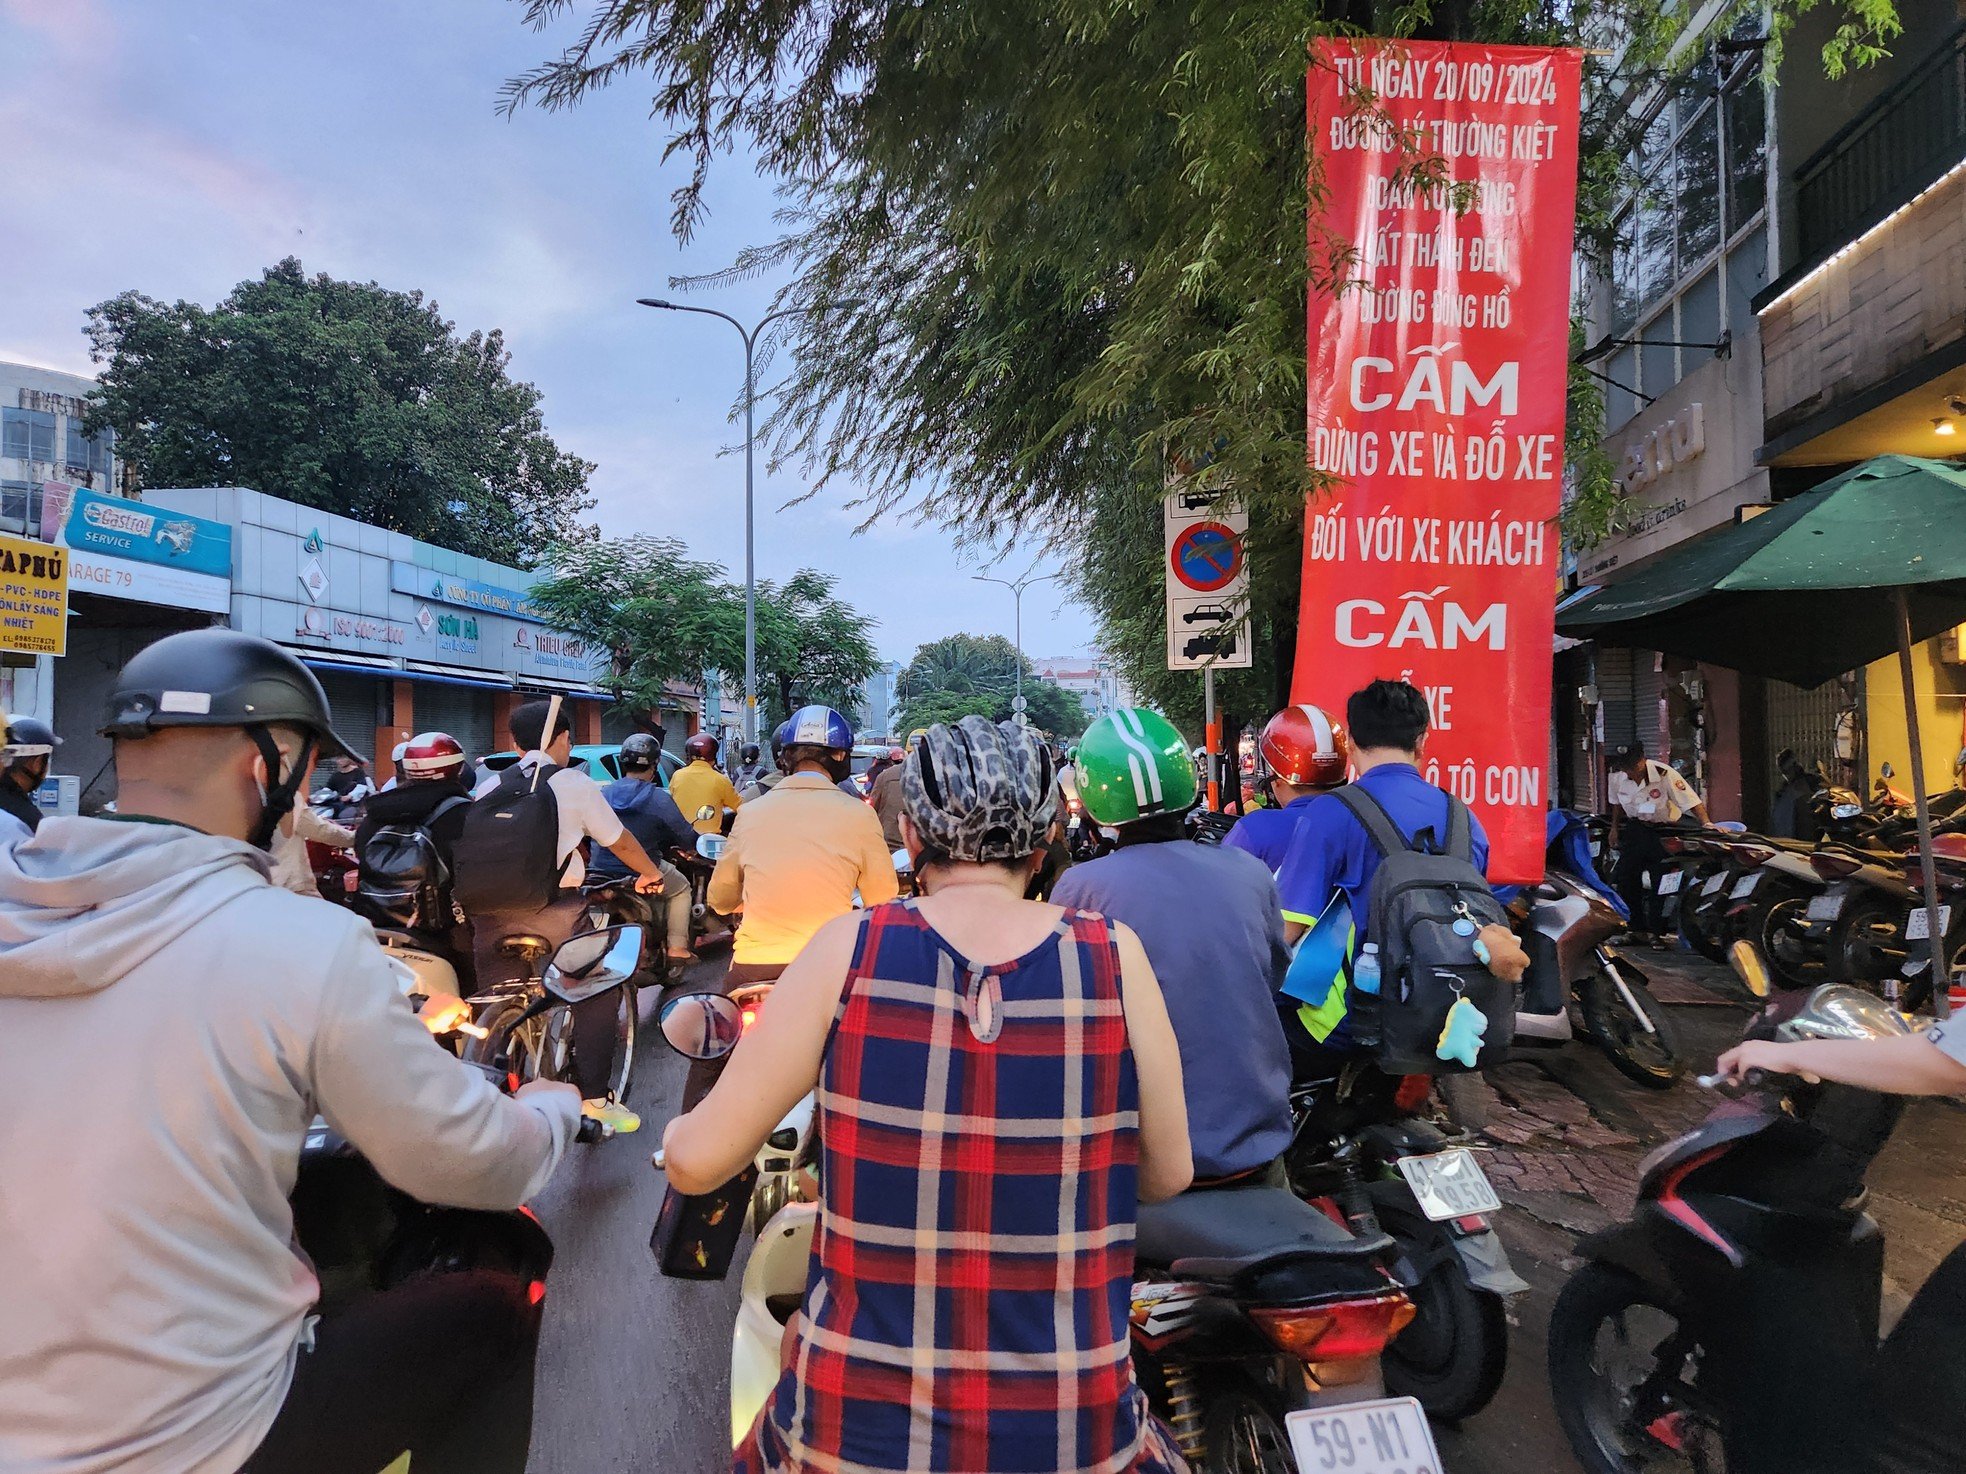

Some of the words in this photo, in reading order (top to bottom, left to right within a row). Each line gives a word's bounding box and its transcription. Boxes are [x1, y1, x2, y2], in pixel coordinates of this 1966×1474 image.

[1333, 47, 1365, 97] TỪ
[1371, 48, 1429, 100] NGÀY
[1433, 60, 1557, 106] 20/09/2024
[1430, 112, 1506, 159] THƯỜNG
[1511, 120, 1558, 168] KIỆT
[1482, 284, 1510, 329] HỒ
[1349, 342, 1519, 416] CẤM
[1315, 416, 1378, 477] DỪNG
[1388, 430, 1424, 477] XE
[1432, 423, 1458, 479] VÀ
[1465, 419, 1506, 481] ĐỖ
[1514, 434, 1555, 480] XE
[84, 531, 132, 549] SERVICE
[1311, 502, 1346, 561] ĐỐI
[1358, 505, 1404, 562] VỚI
[1410, 517, 1441, 564] XE
[1448, 509, 1544, 566] KHÁCH
[116, 570, 132, 586] 79
[333, 617, 351, 637] ISO
[1334, 585, 1507, 651] CẤM
[1424, 686, 1453, 730] XE
[1447, 757, 1477, 806] TÔ
[1484, 765, 1539, 806] CON
[1309, 1411, 1410, 1469] 59-N1
